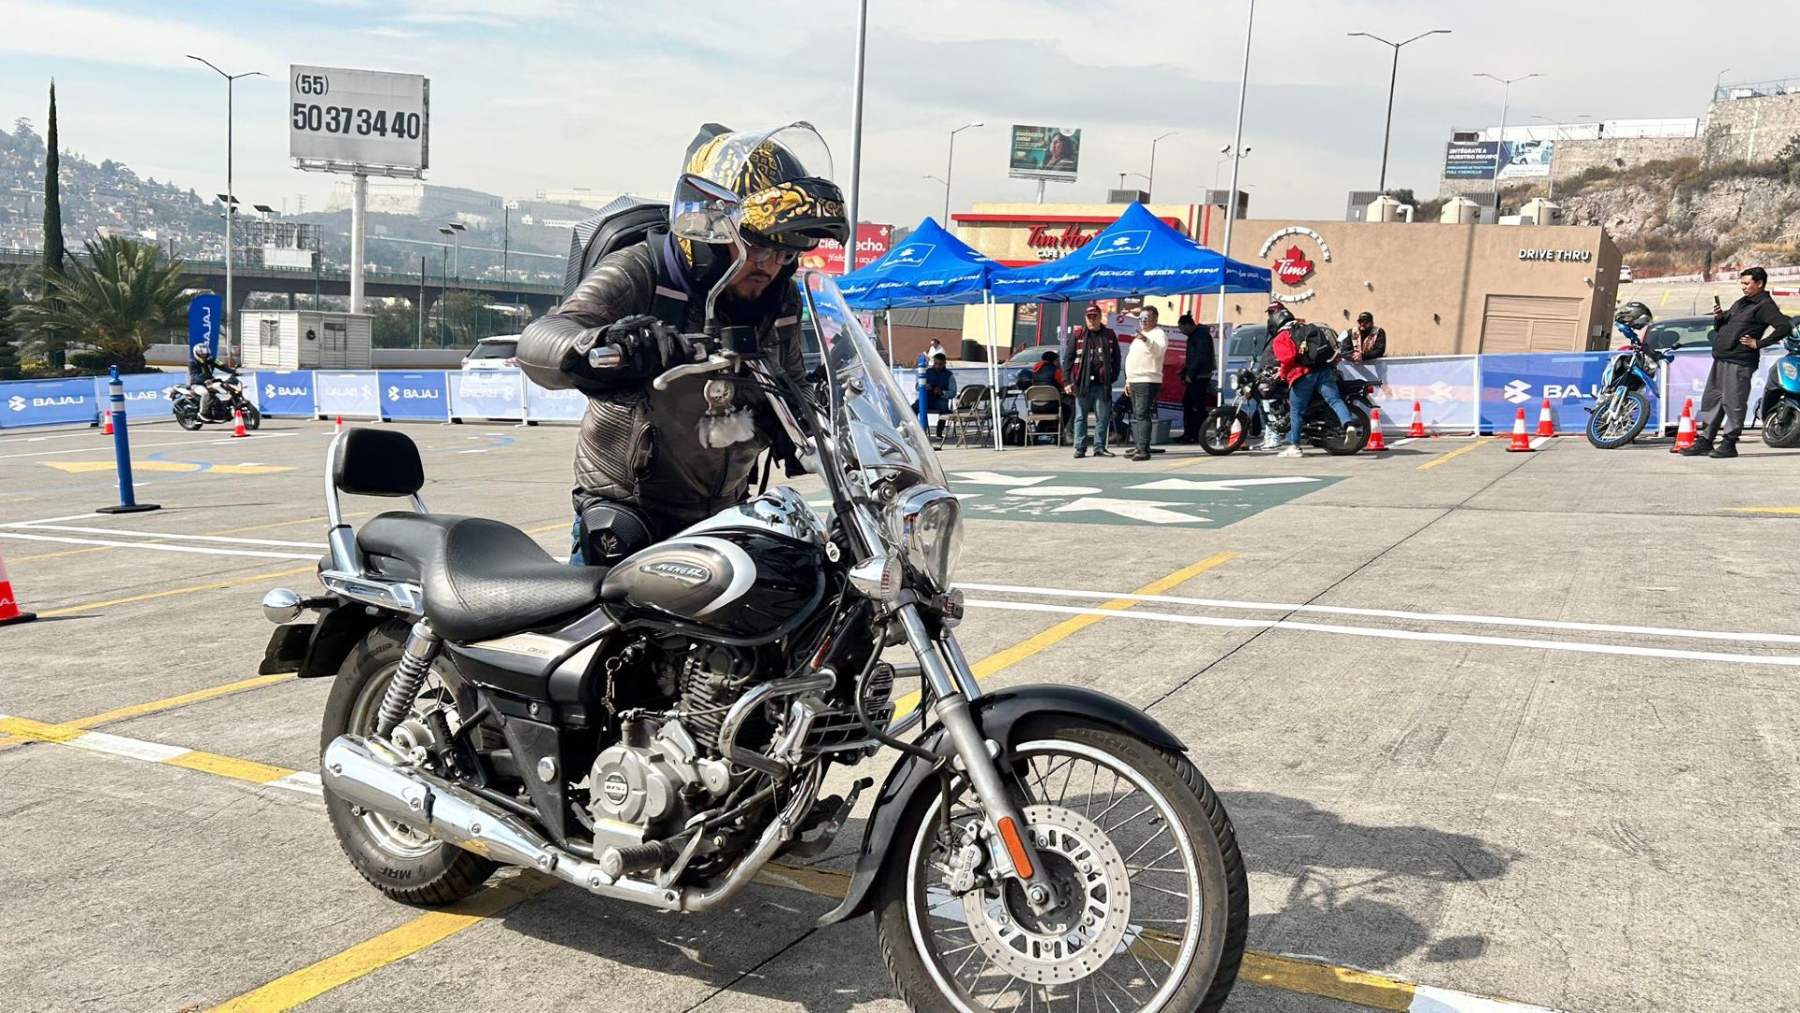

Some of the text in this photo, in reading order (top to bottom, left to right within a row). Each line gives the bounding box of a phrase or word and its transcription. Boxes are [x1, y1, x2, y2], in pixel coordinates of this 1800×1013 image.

[295, 72, 329, 96] (55)
[1027, 224, 1059, 249] Tim
[1519, 248, 1590, 260] DRIVE THRU
[1277, 259, 1308, 275] Tims
[278, 386, 308, 396] BAJAJ
[403, 388, 439, 398] BAJAJ
[1543, 384, 1602, 399] BAJ
[32, 395, 84, 407] BAJAJ
[377, 866, 412, 880] MRF
